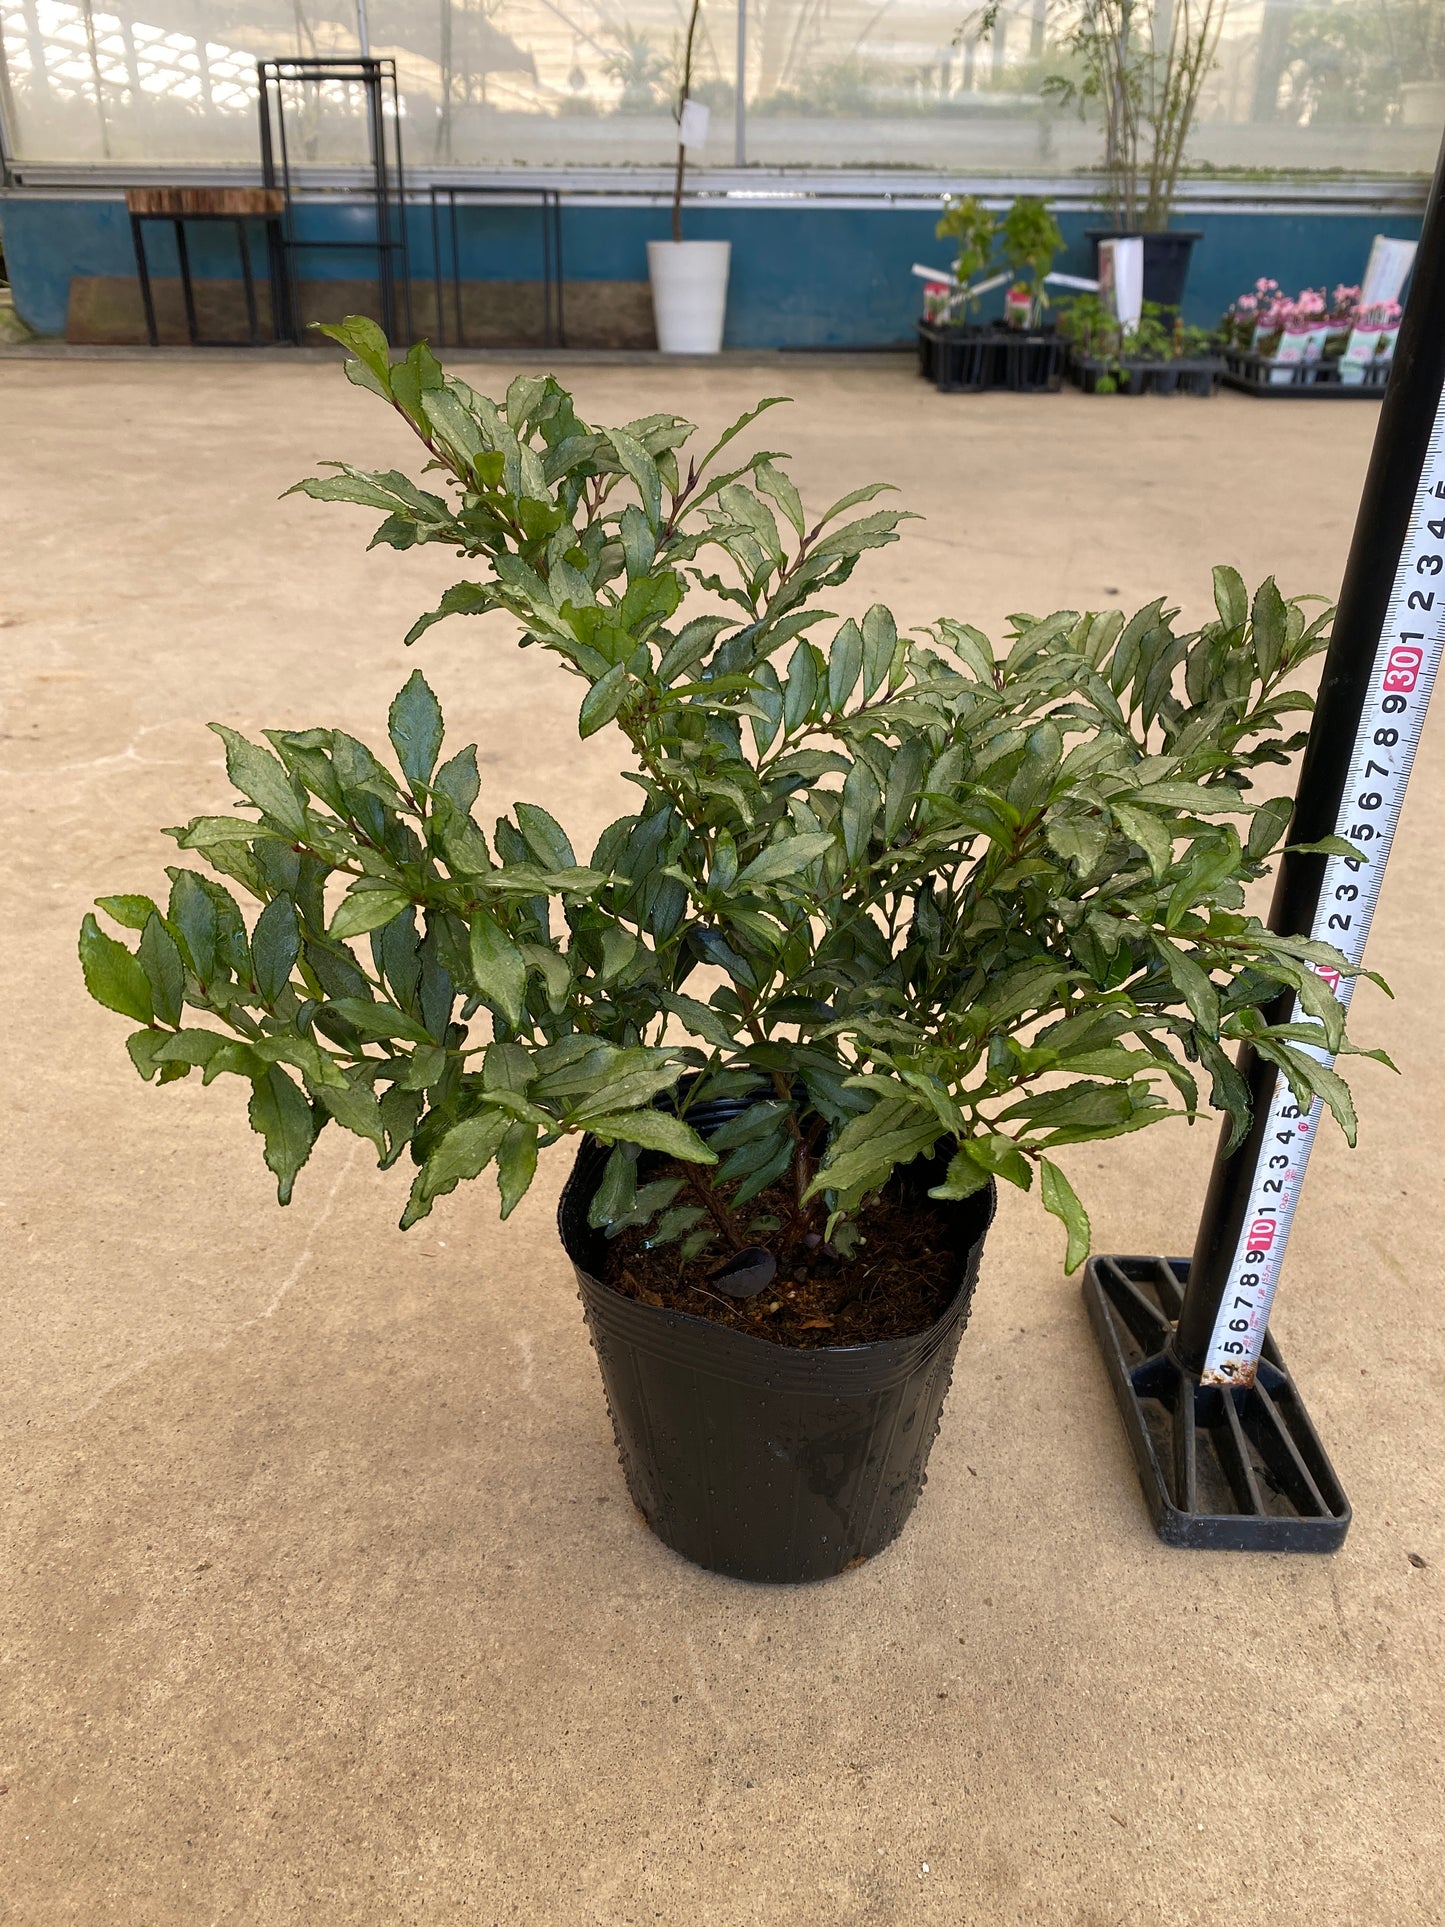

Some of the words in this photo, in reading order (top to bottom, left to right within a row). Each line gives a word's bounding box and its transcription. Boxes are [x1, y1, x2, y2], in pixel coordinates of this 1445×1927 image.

[1427, 517, 1445, 540] 4
[1417, 554, 1444, 576] 3
[1408, 590, 1436, 612] 2
[1399, 632, 1425, 644] 1
[1386, 651, 1420, 687] 30
[1382, 694, 1407, 714] 9
[1374, 728, 1399, 747] 8
[1365, 760, 1390, 778] 7
[1357, 792, 1383, 811] 6
[1350, 824, 1375, 841] 5
[1335, 885, 1359, 902] 3
[1328, 914, 1352, 931] 2
[1281, 1104, 1302, 1119] 5
[1276, 1130, 1296, 1145] 4
[1269, 1155, 1289, 1169] 3
[1263, 1179, 1284, 1193] 2
[1257, 1207, 1276, 1216] 1
[1249, 1222, 1273, 1245] 10
[1245, 1250, 1265, 1264] 9
[1240, 1274, 1260, 1287] 8
[1233, 1297, 1253, 1309] 7
[1229, 1319, 1249, 1332] 6
[1224, 1342, 1243, 1355] 5
[1220, 1364, 1239, 1377] 4
